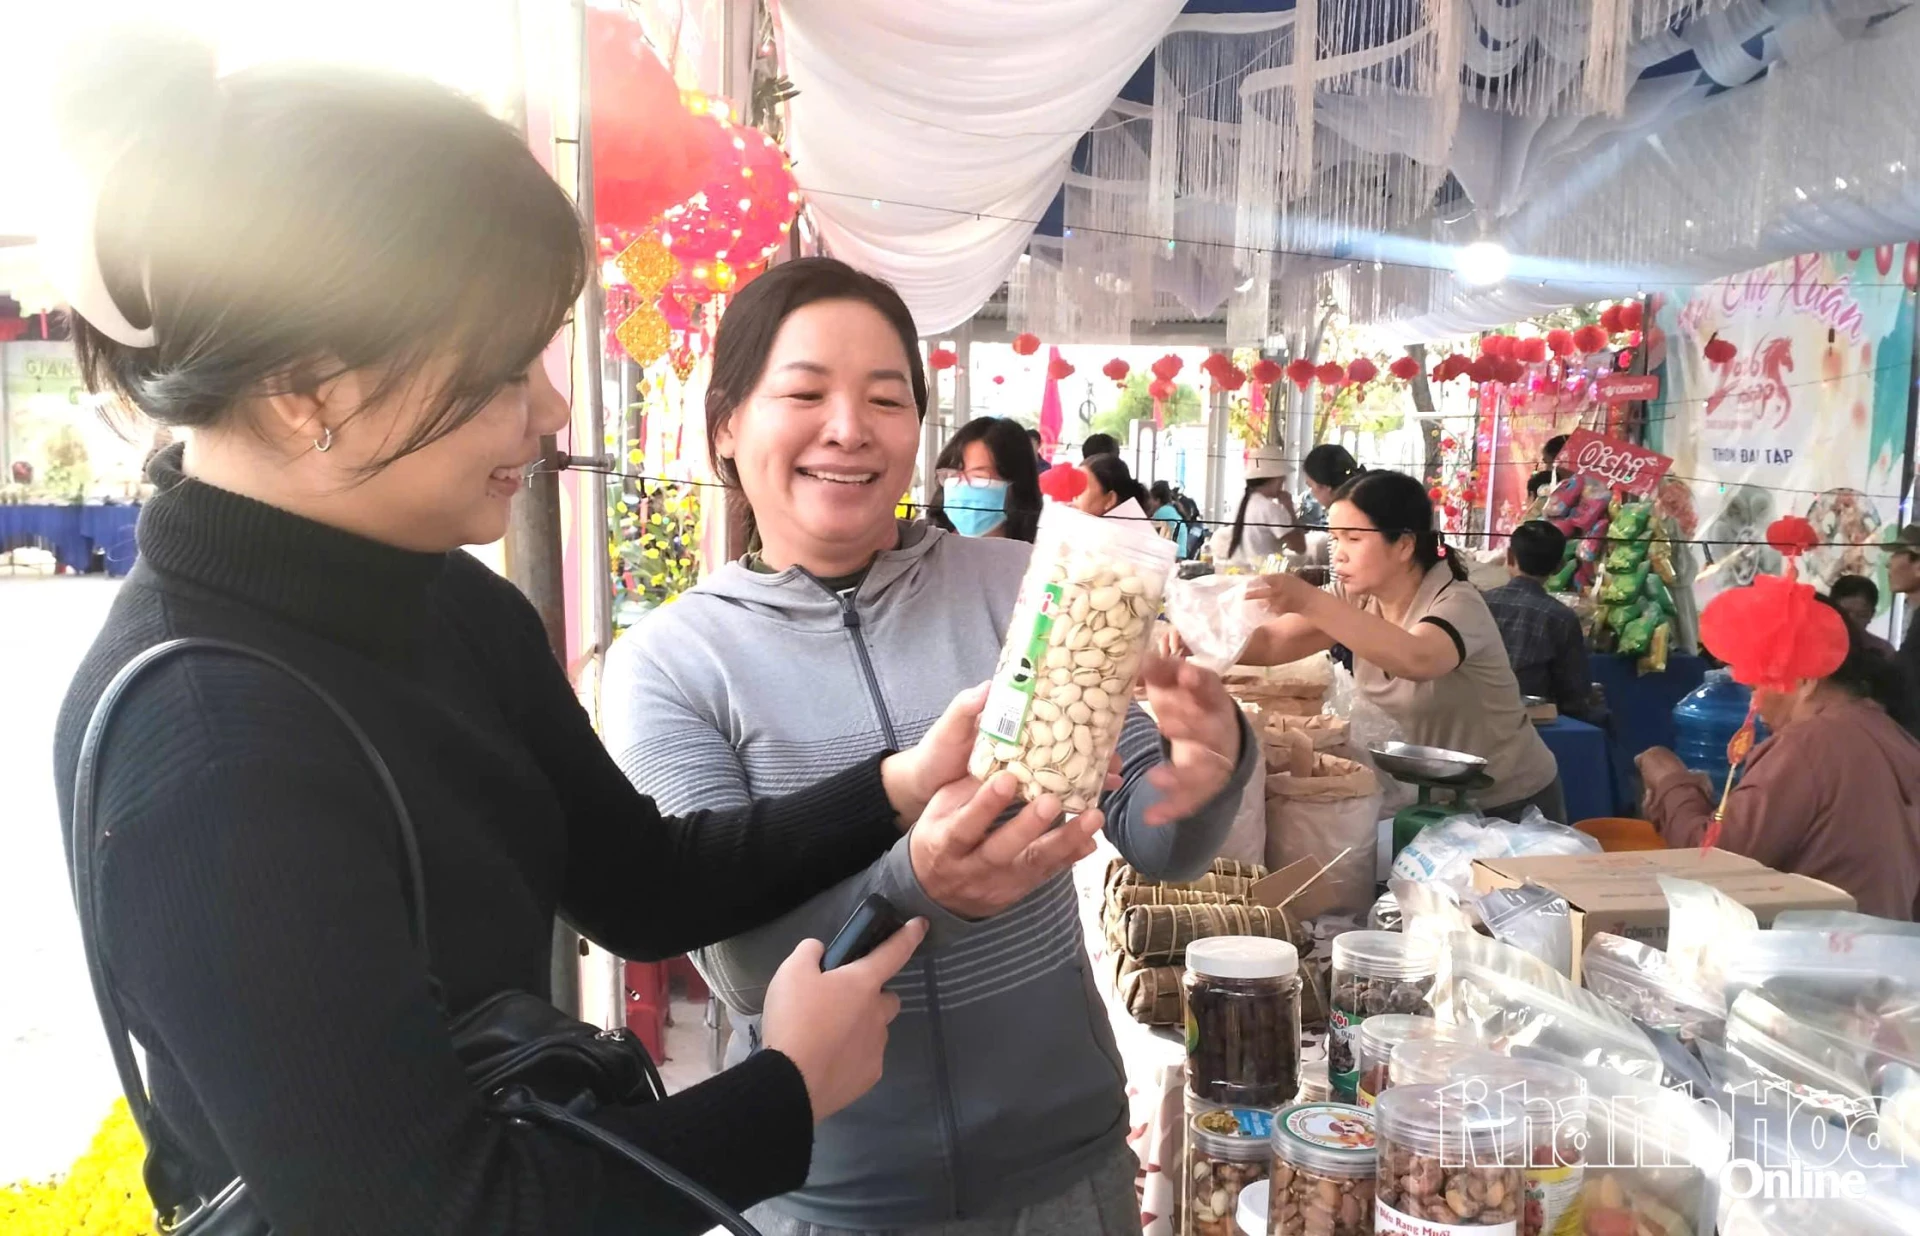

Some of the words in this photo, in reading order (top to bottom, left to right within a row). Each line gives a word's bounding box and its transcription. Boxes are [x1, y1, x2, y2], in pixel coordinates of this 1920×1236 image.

[1777, 252, 1864, 341] Xuân
[1577, 440, 1645, 484] Oishi
[1395, 1217, 1419, 1235] Rang
